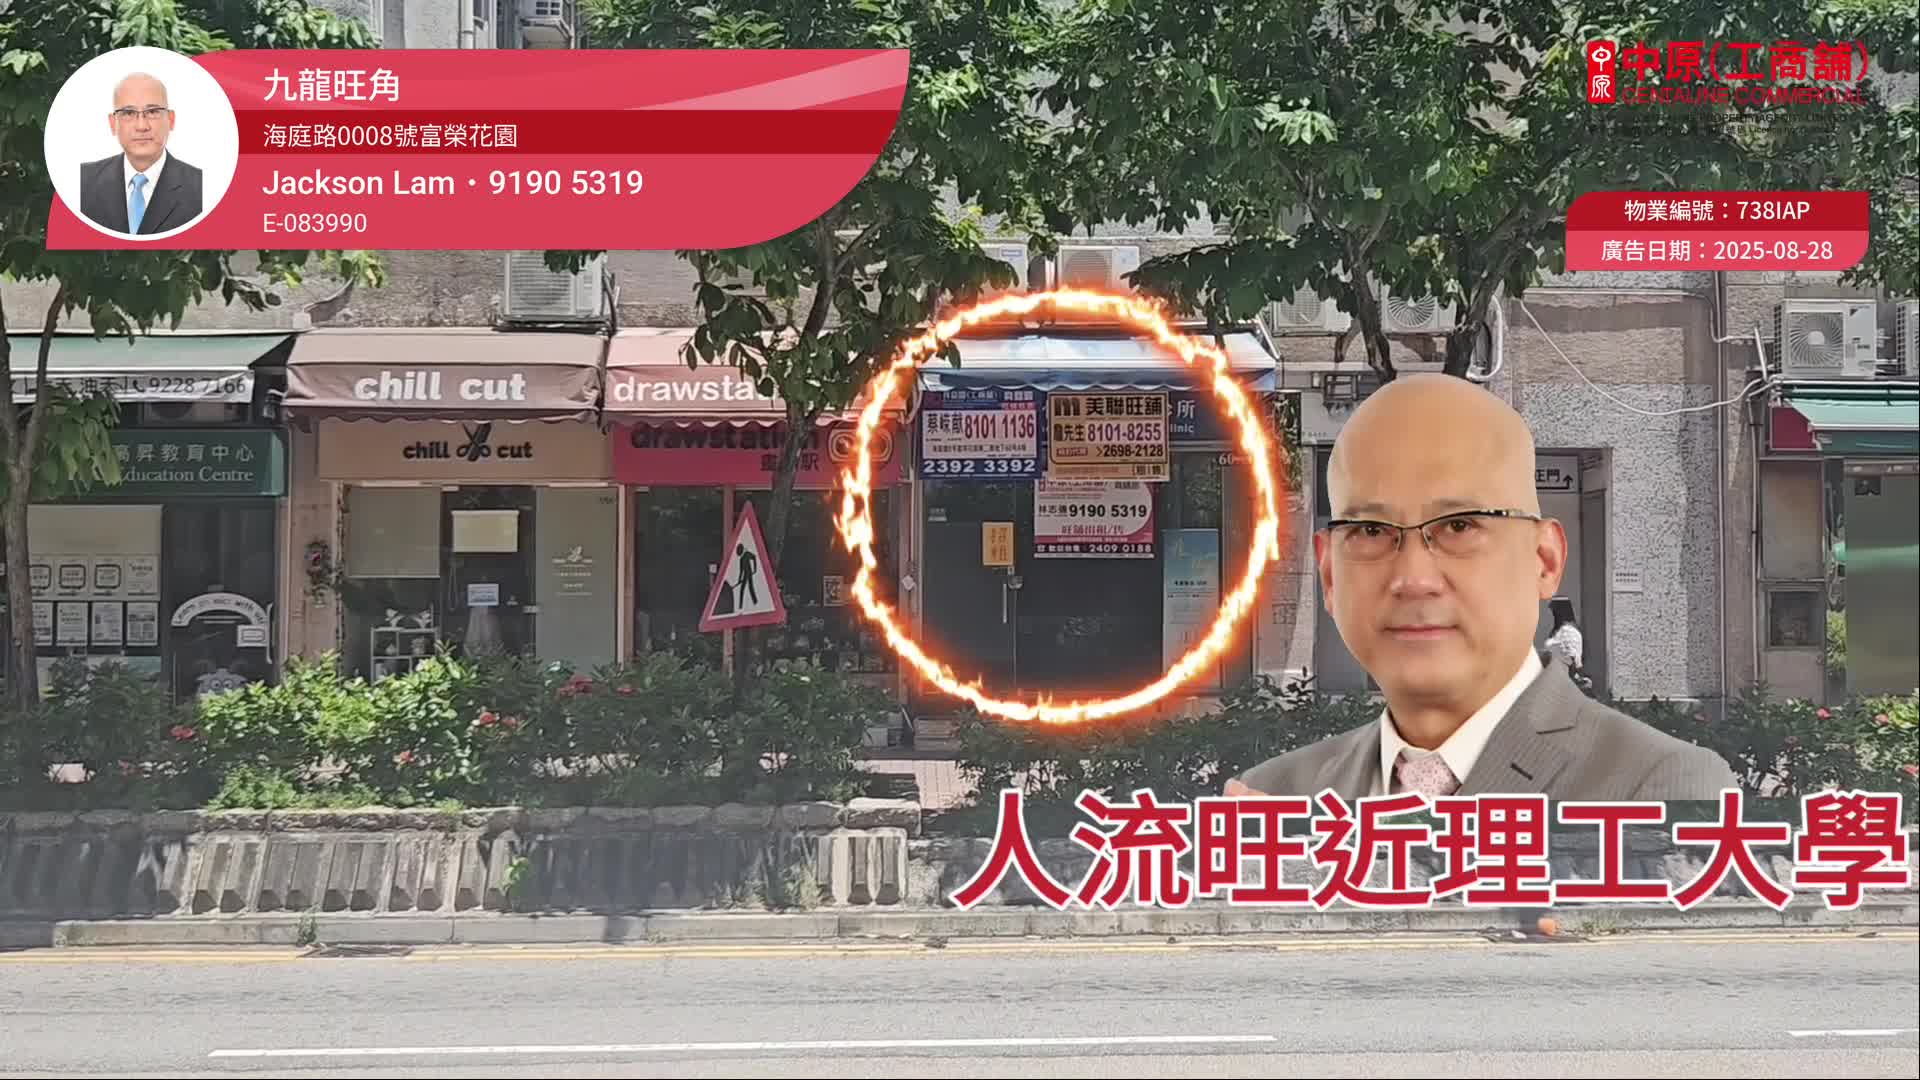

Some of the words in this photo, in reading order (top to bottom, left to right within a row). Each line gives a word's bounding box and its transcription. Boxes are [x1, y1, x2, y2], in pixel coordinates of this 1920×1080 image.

[152, 377, 194, 393] 9228
[201, 377, 246, 393] 7166
[354, 371, 441, 400] chill
[459, 373, 526, 401] cut
[612, 374, 757, 402] drawsta
[1086, 397, 1162, 415] 美聯旺舖
[964, 414, 997, 439] 8101
[1002, 414, 1035, 438] 1136
[1087, 423, 1161, 442] 8101-8255
[402, 442, 451, 459] chill
[496, 443, 533, 459] cut
[1103, 444, 1164, 458] 2698-2128
[200, 466, 255, 482] Centre
[923, 460, 975, 473] 2392
[984, 460, 1036, 472] 3392
[1069, 504, 1106, 518] 9190
[1111, 504, 1148, 518] 5319
[1089, 544, 1119, 553] 2409
[1122, 544, 1152, 553] 0188
